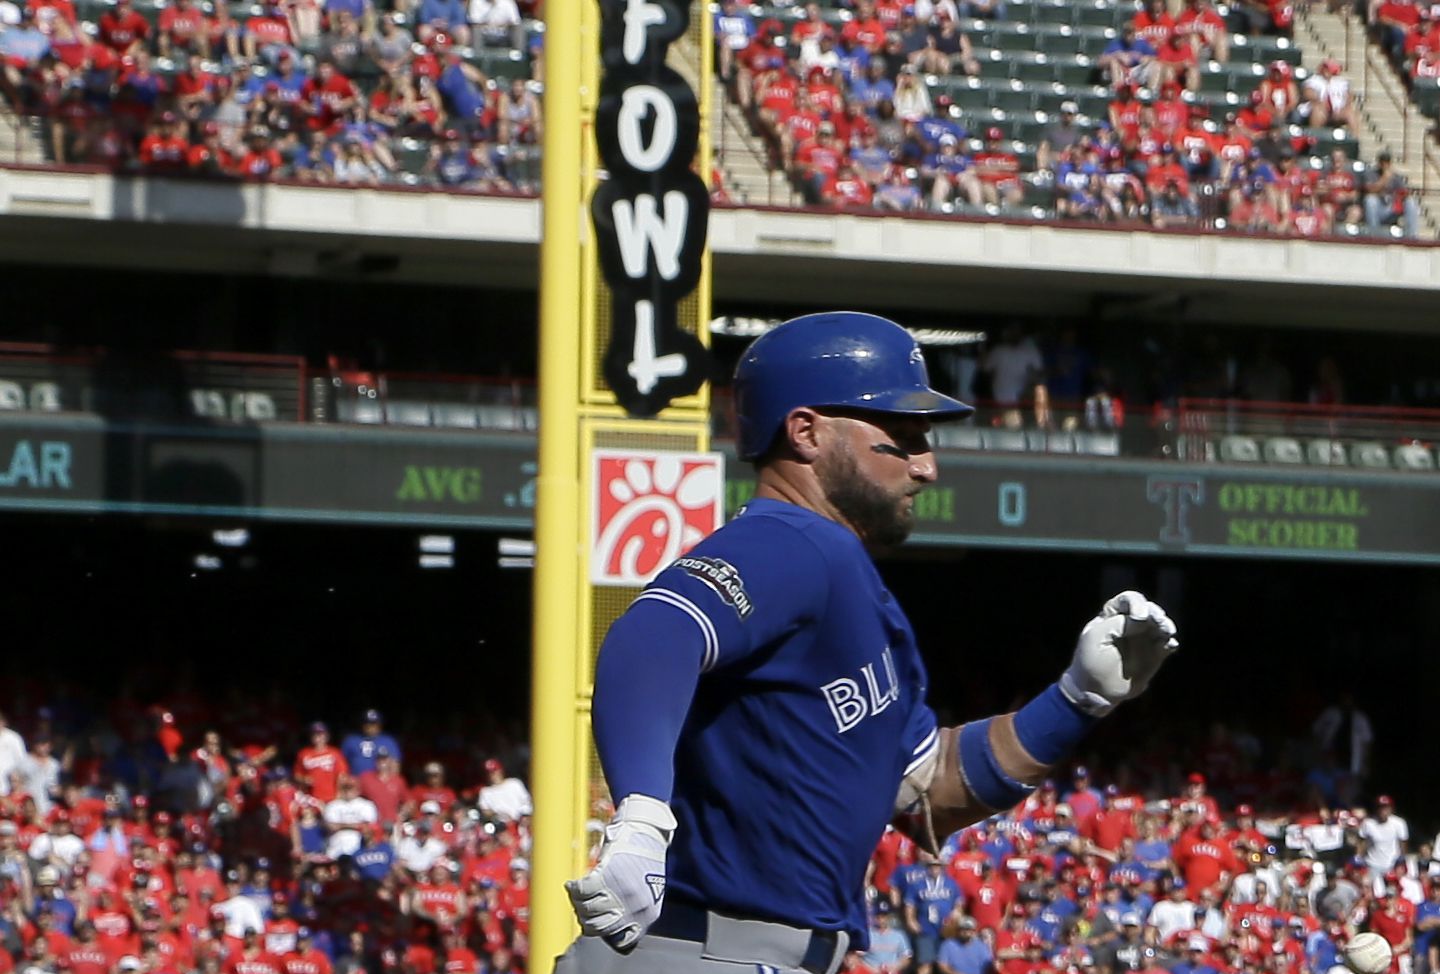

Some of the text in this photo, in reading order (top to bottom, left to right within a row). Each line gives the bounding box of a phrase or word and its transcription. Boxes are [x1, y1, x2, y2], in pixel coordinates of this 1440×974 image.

[397, 474, 483, 503] AVG
[1218, 481, 1370, 517] OFFICIAL
[1228, 517, 1359, 550] SCORER
[673, 558, 752, 615] POSTSEASON
